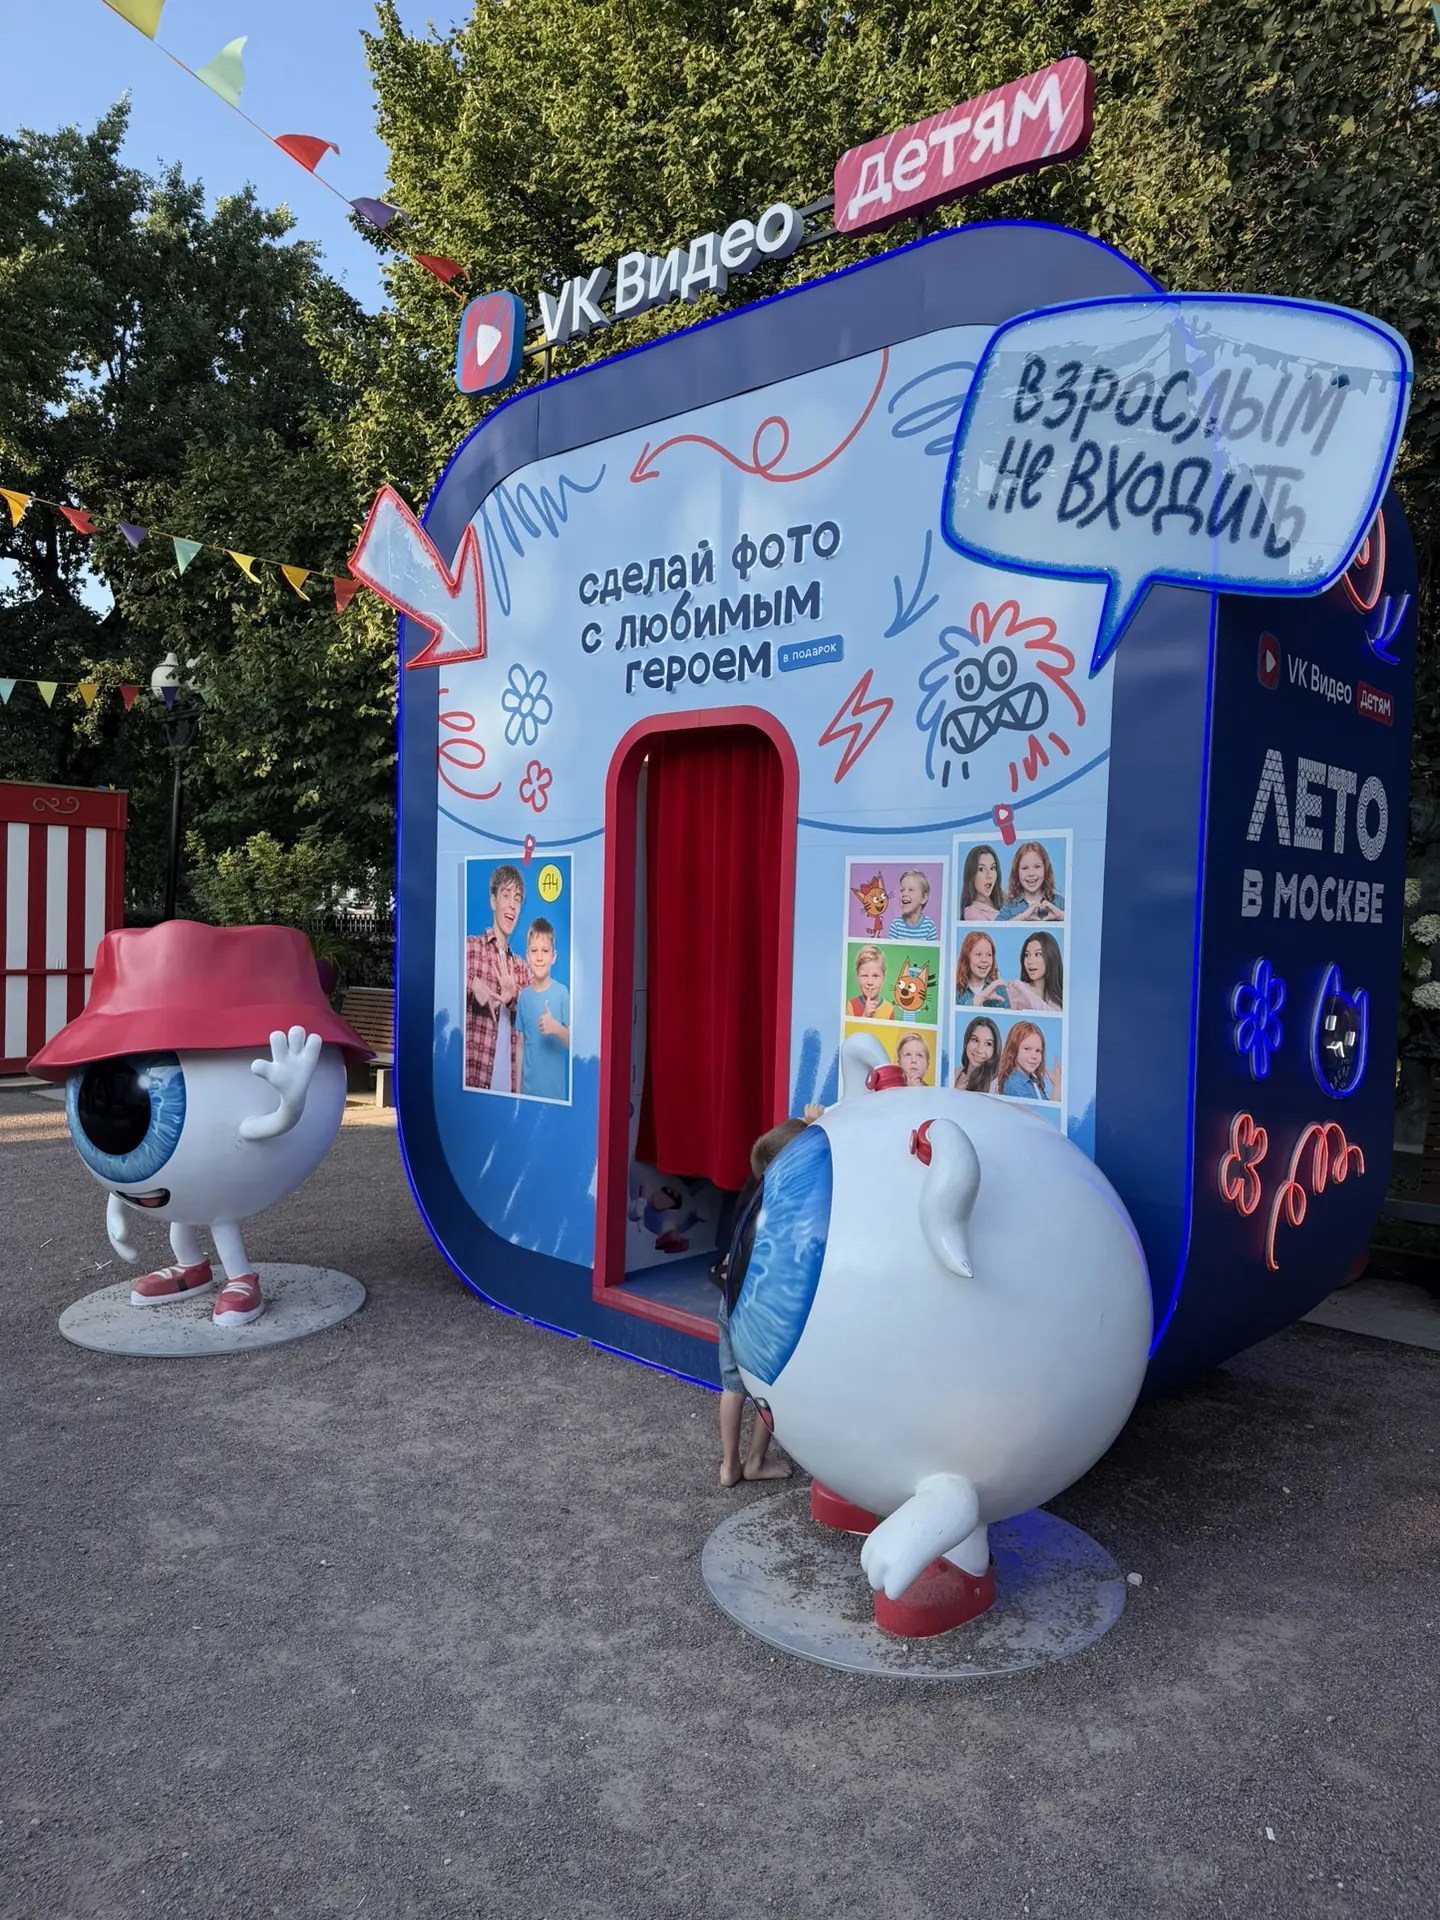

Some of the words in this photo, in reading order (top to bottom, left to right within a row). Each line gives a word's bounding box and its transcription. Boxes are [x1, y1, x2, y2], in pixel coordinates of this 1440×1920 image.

[538, 264, 611, 345] VK
[616, 203, 803, 318] Видео
[578, 539, 715, 606] сделай
[731, 520, 841, 580] фото
[581, 622, 602, 654] с
[615, 580, 822, 652] любимым
[625, 640, 773, 695] героем
[1287, 653, 1308, 689] VK
[1311, 663, 1352, 705] Видео
[1245, 748, 1389, 862] ЛЕТО
[1241, 868, 1264, 919] В
[1273, 871, 1386, 924] МОСКВЕ
